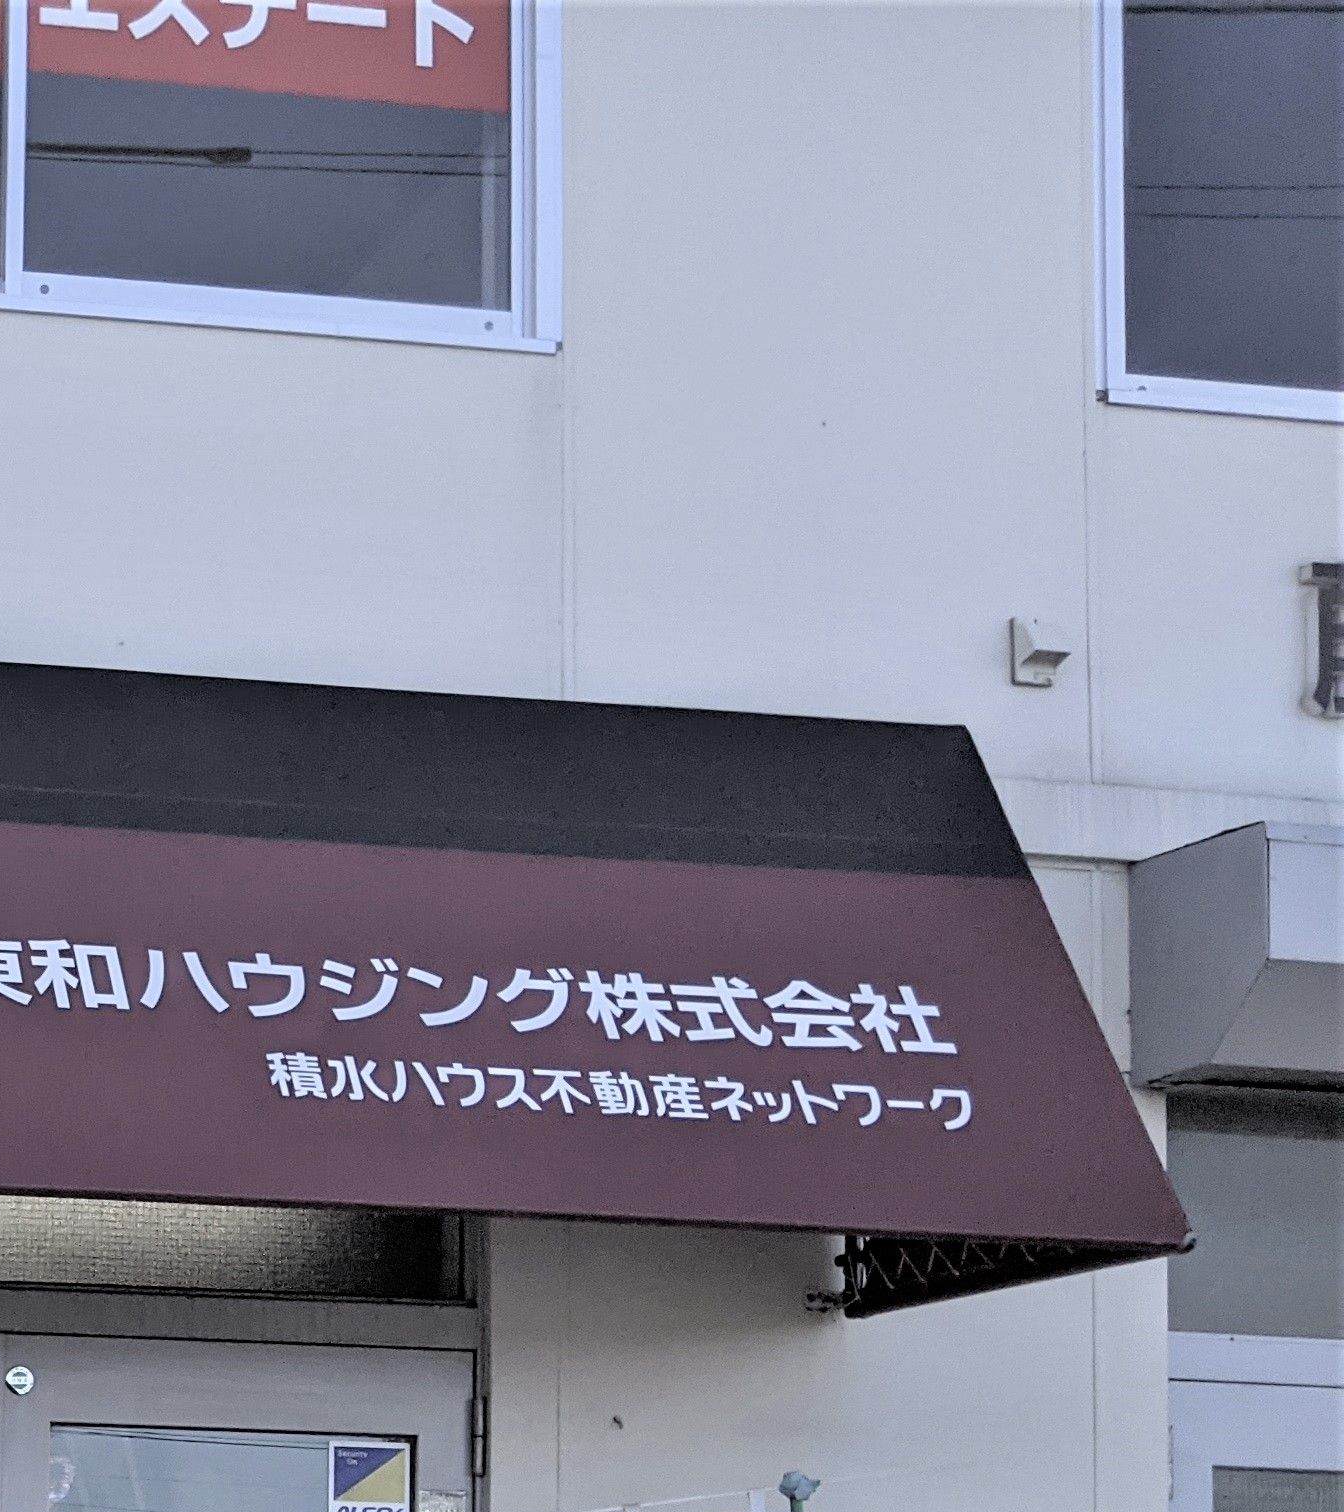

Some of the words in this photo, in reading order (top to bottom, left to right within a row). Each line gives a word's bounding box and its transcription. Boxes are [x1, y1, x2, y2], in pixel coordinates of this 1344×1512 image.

[265, 1051, 973, 1131] 積水ハウス不動産ネットワーク
